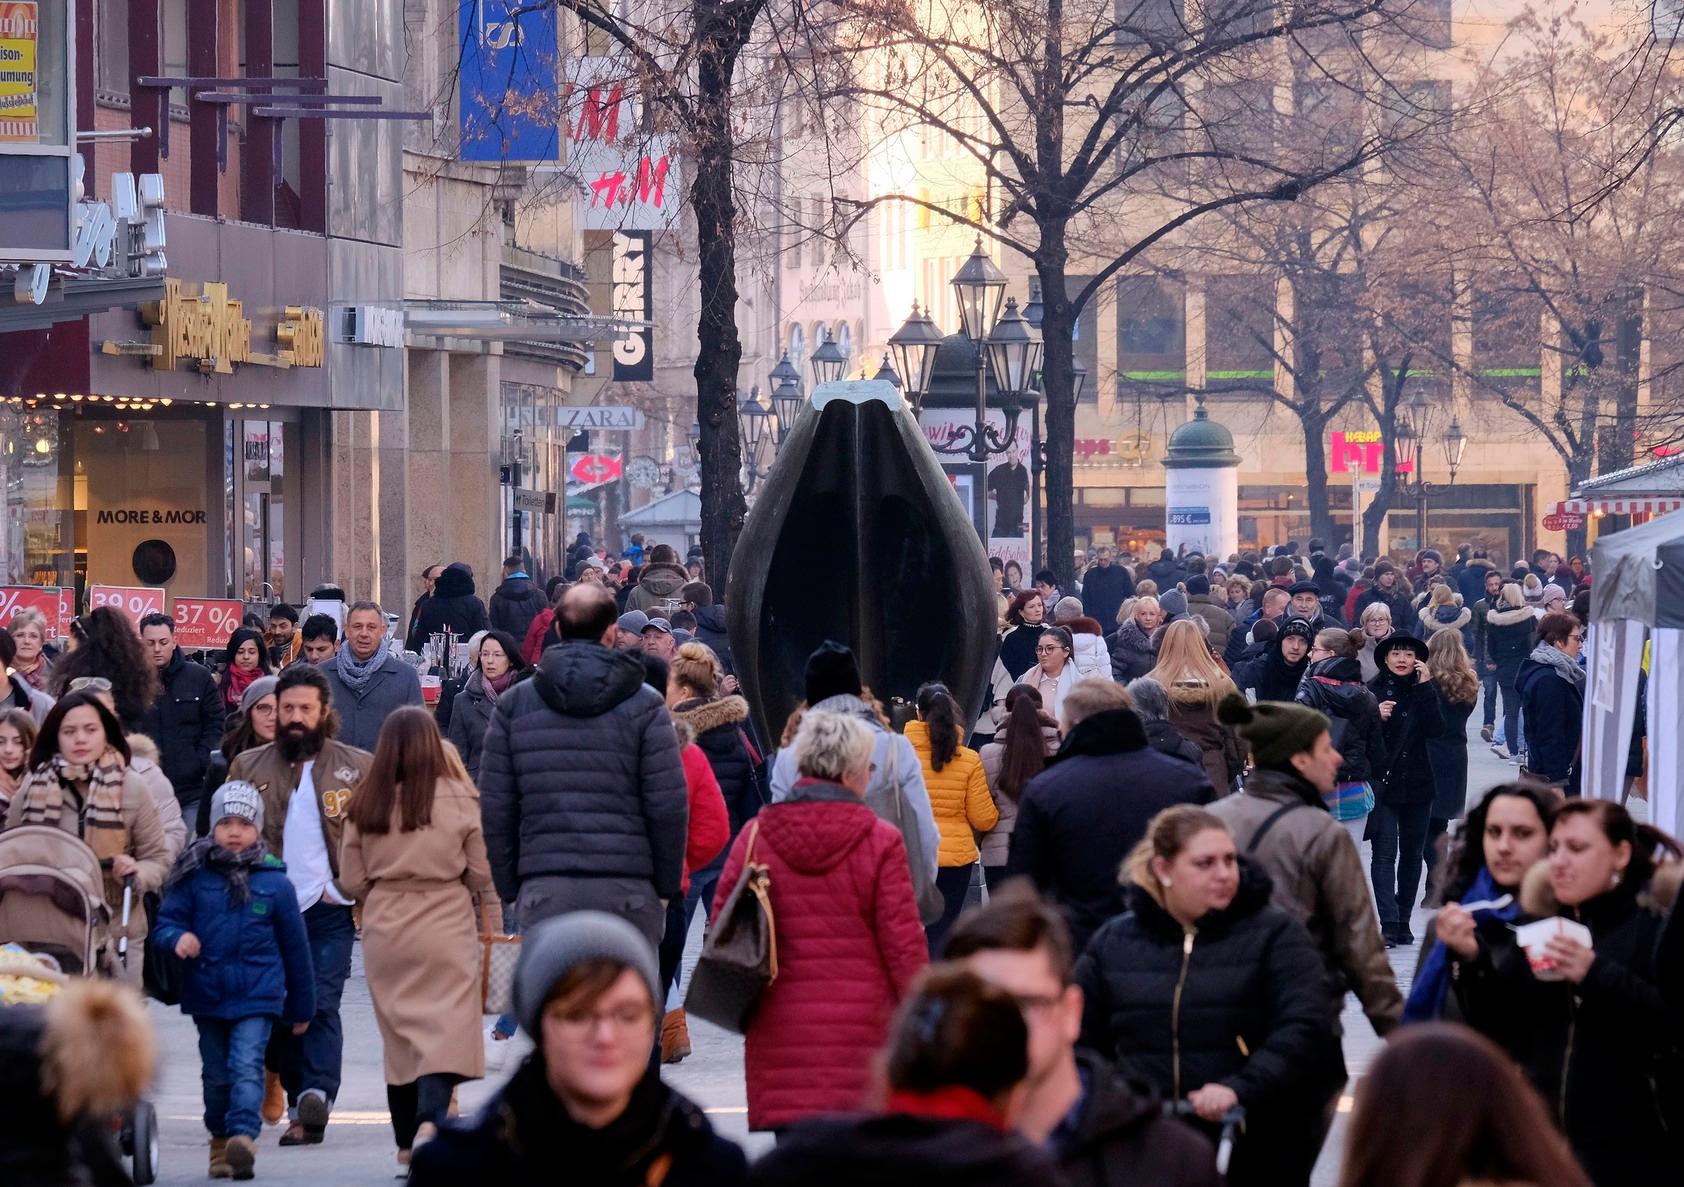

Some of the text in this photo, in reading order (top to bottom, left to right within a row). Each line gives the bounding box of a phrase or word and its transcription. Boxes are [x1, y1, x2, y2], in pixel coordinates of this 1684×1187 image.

[590, 154, 669, 209] H&M
[567, 409, 632, 427] ZARA
[175, 604, 239, 634] 37 %
